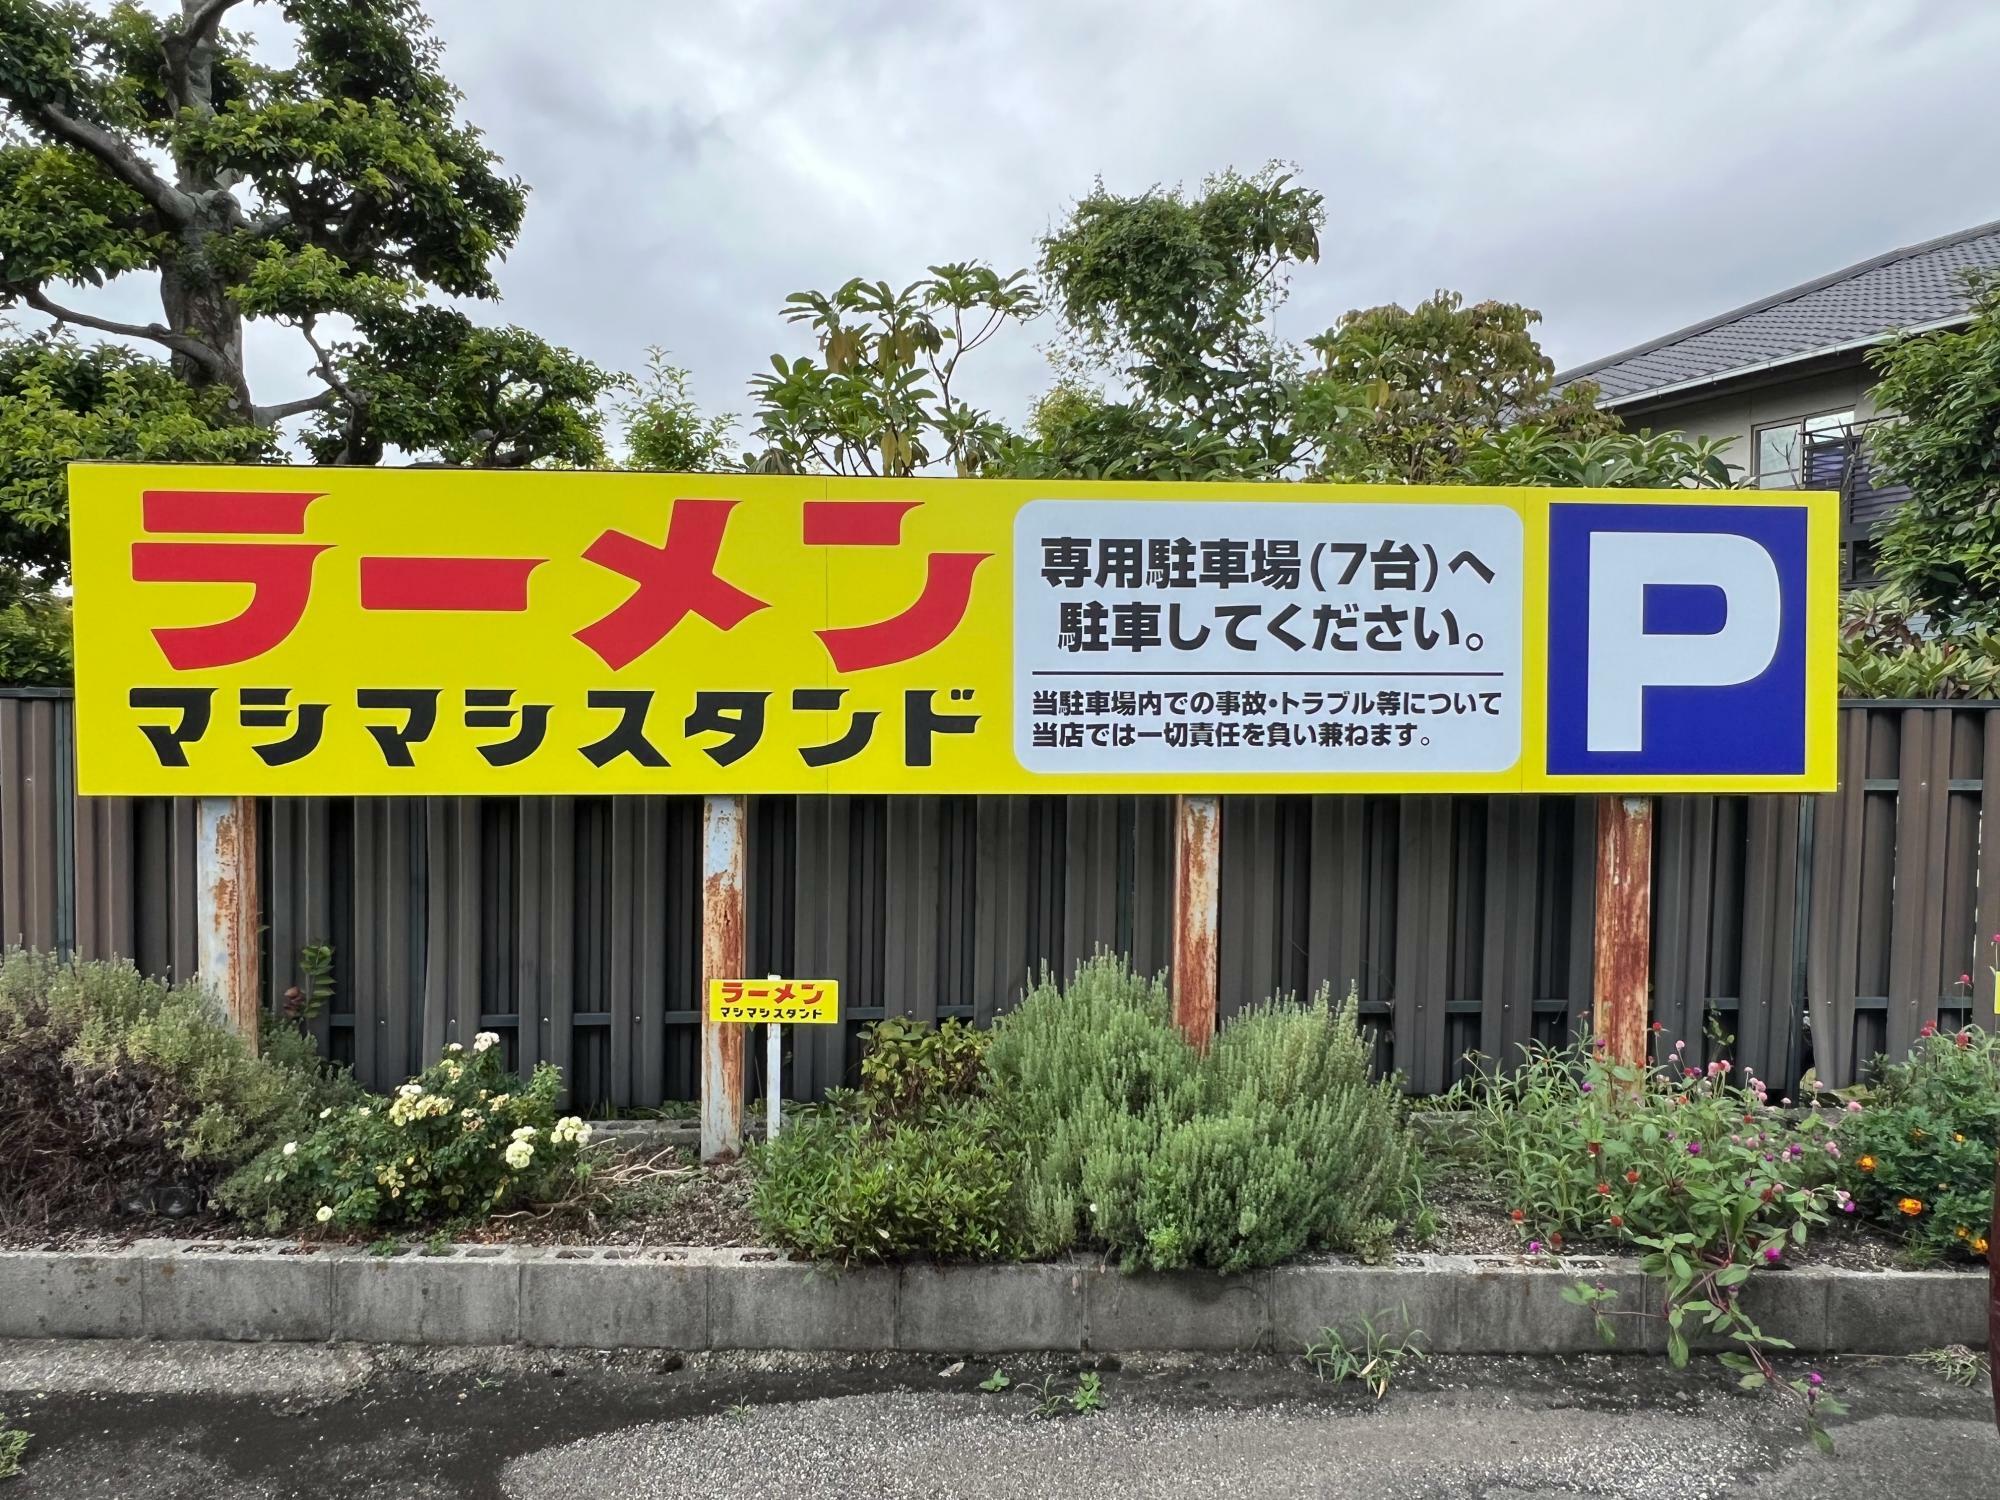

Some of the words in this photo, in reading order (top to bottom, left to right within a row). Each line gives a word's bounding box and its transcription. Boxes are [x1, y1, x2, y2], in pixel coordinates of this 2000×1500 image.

[131, 490, 995, 674] ラーメン
[1041, 537, 1495, 592] 専用駐車場(7台)へ
[1058, 601, 1484, 653] 駐車してください。
[1587, 532, 1781, 752] P
[129, 687, 982, 768] マシマシスタンド
[1032, 690, 1500, 716] 当駐車場内での事故・トラブル等について
[1032, 722, 1430, 748] 当店では一切責任を負い兼ねます。
[721, 982, 824, 1005] ラーメン
